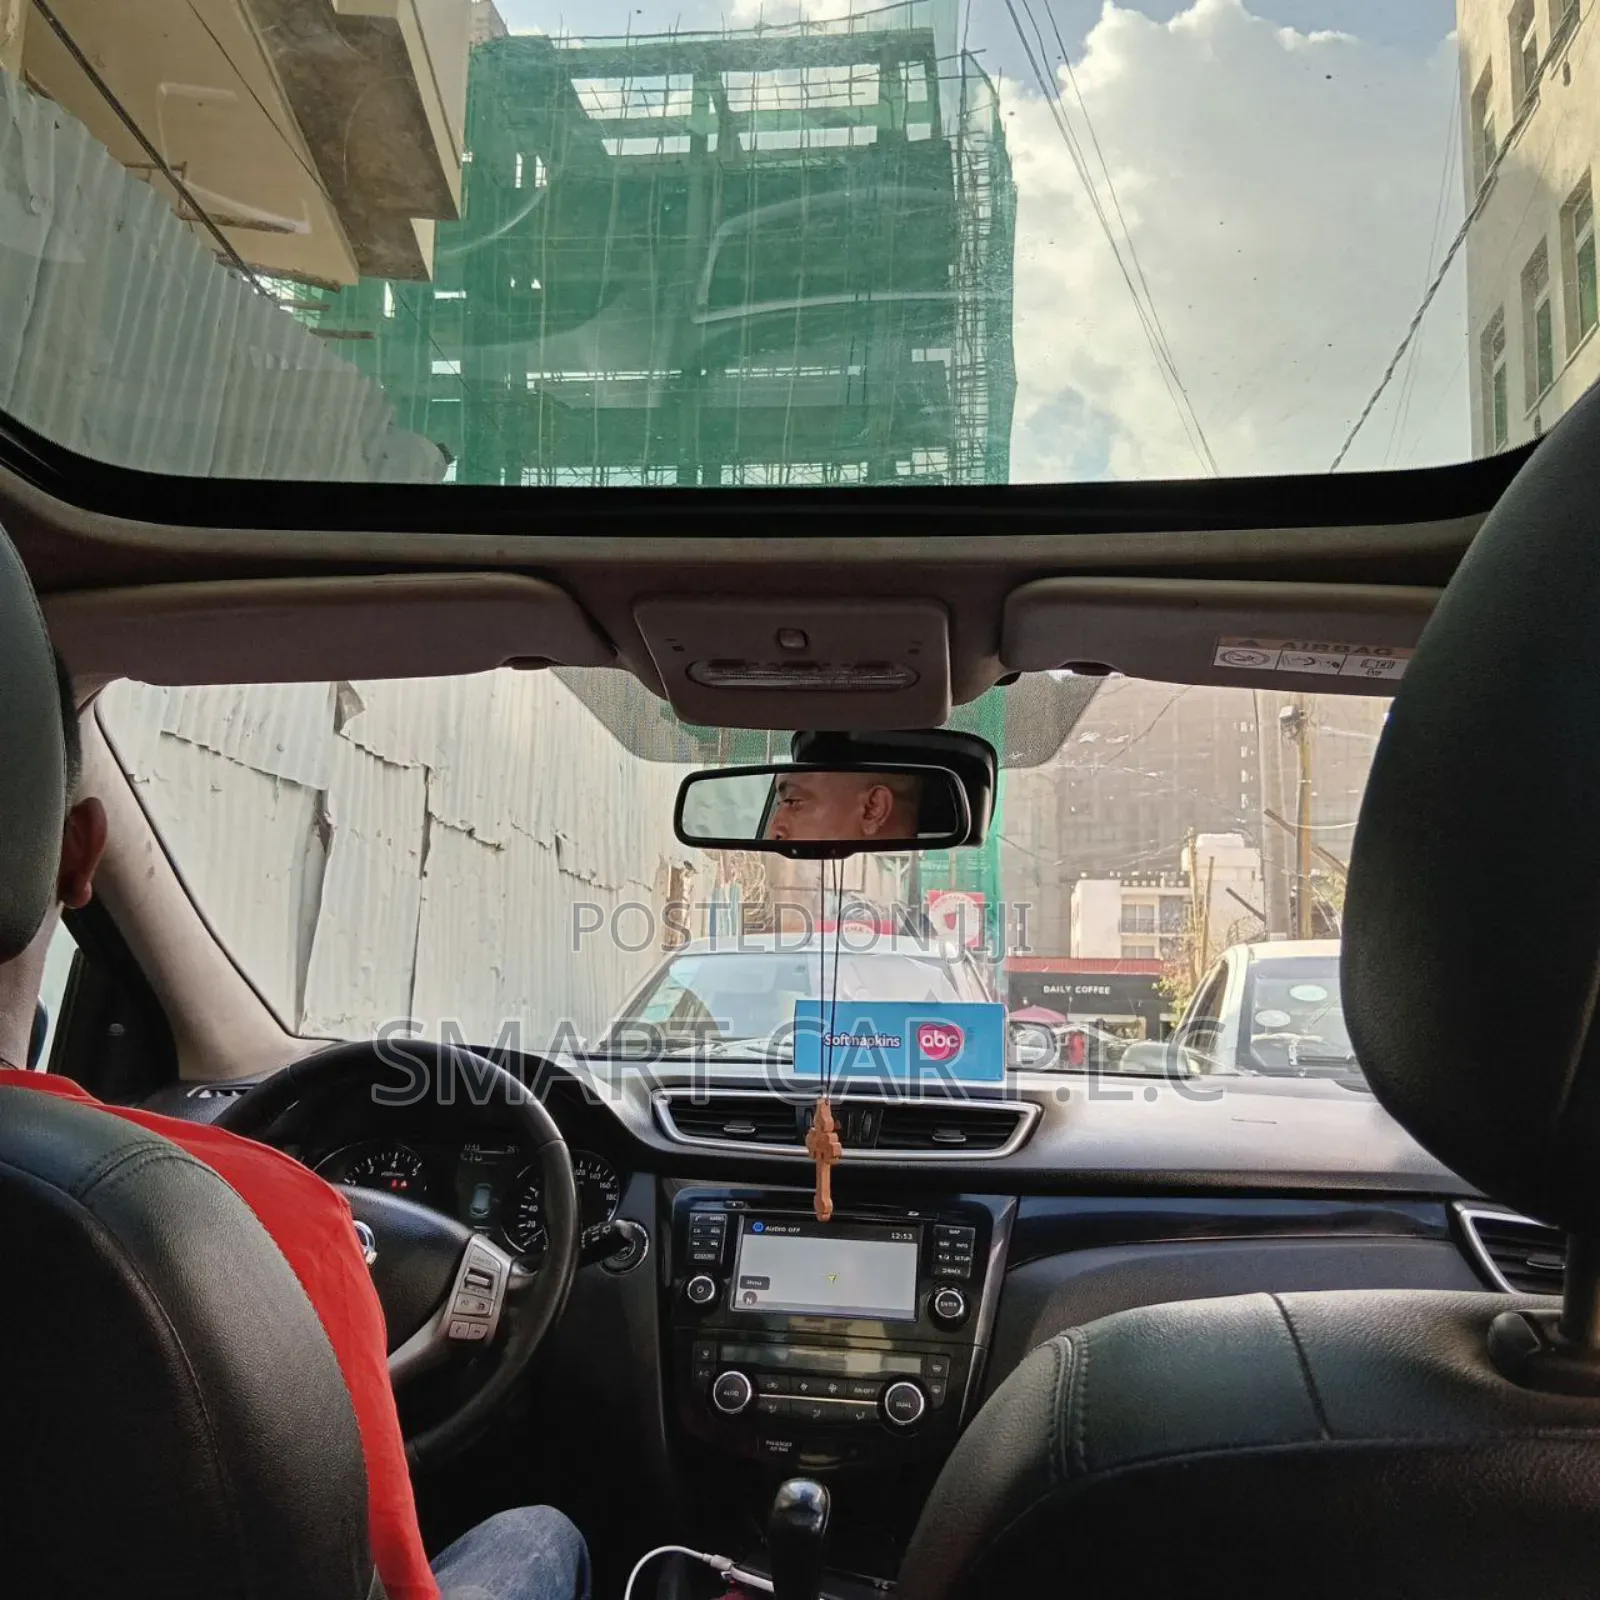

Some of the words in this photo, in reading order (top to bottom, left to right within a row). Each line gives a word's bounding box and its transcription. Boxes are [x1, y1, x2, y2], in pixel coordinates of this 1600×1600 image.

[1281, 641, 1393, 656] AIRBAG
[1043, 985, 1072, 994] DAILY
[1075, 985, 1111, 995] COFFEE
[920, 1030, 960, 1048] abc
